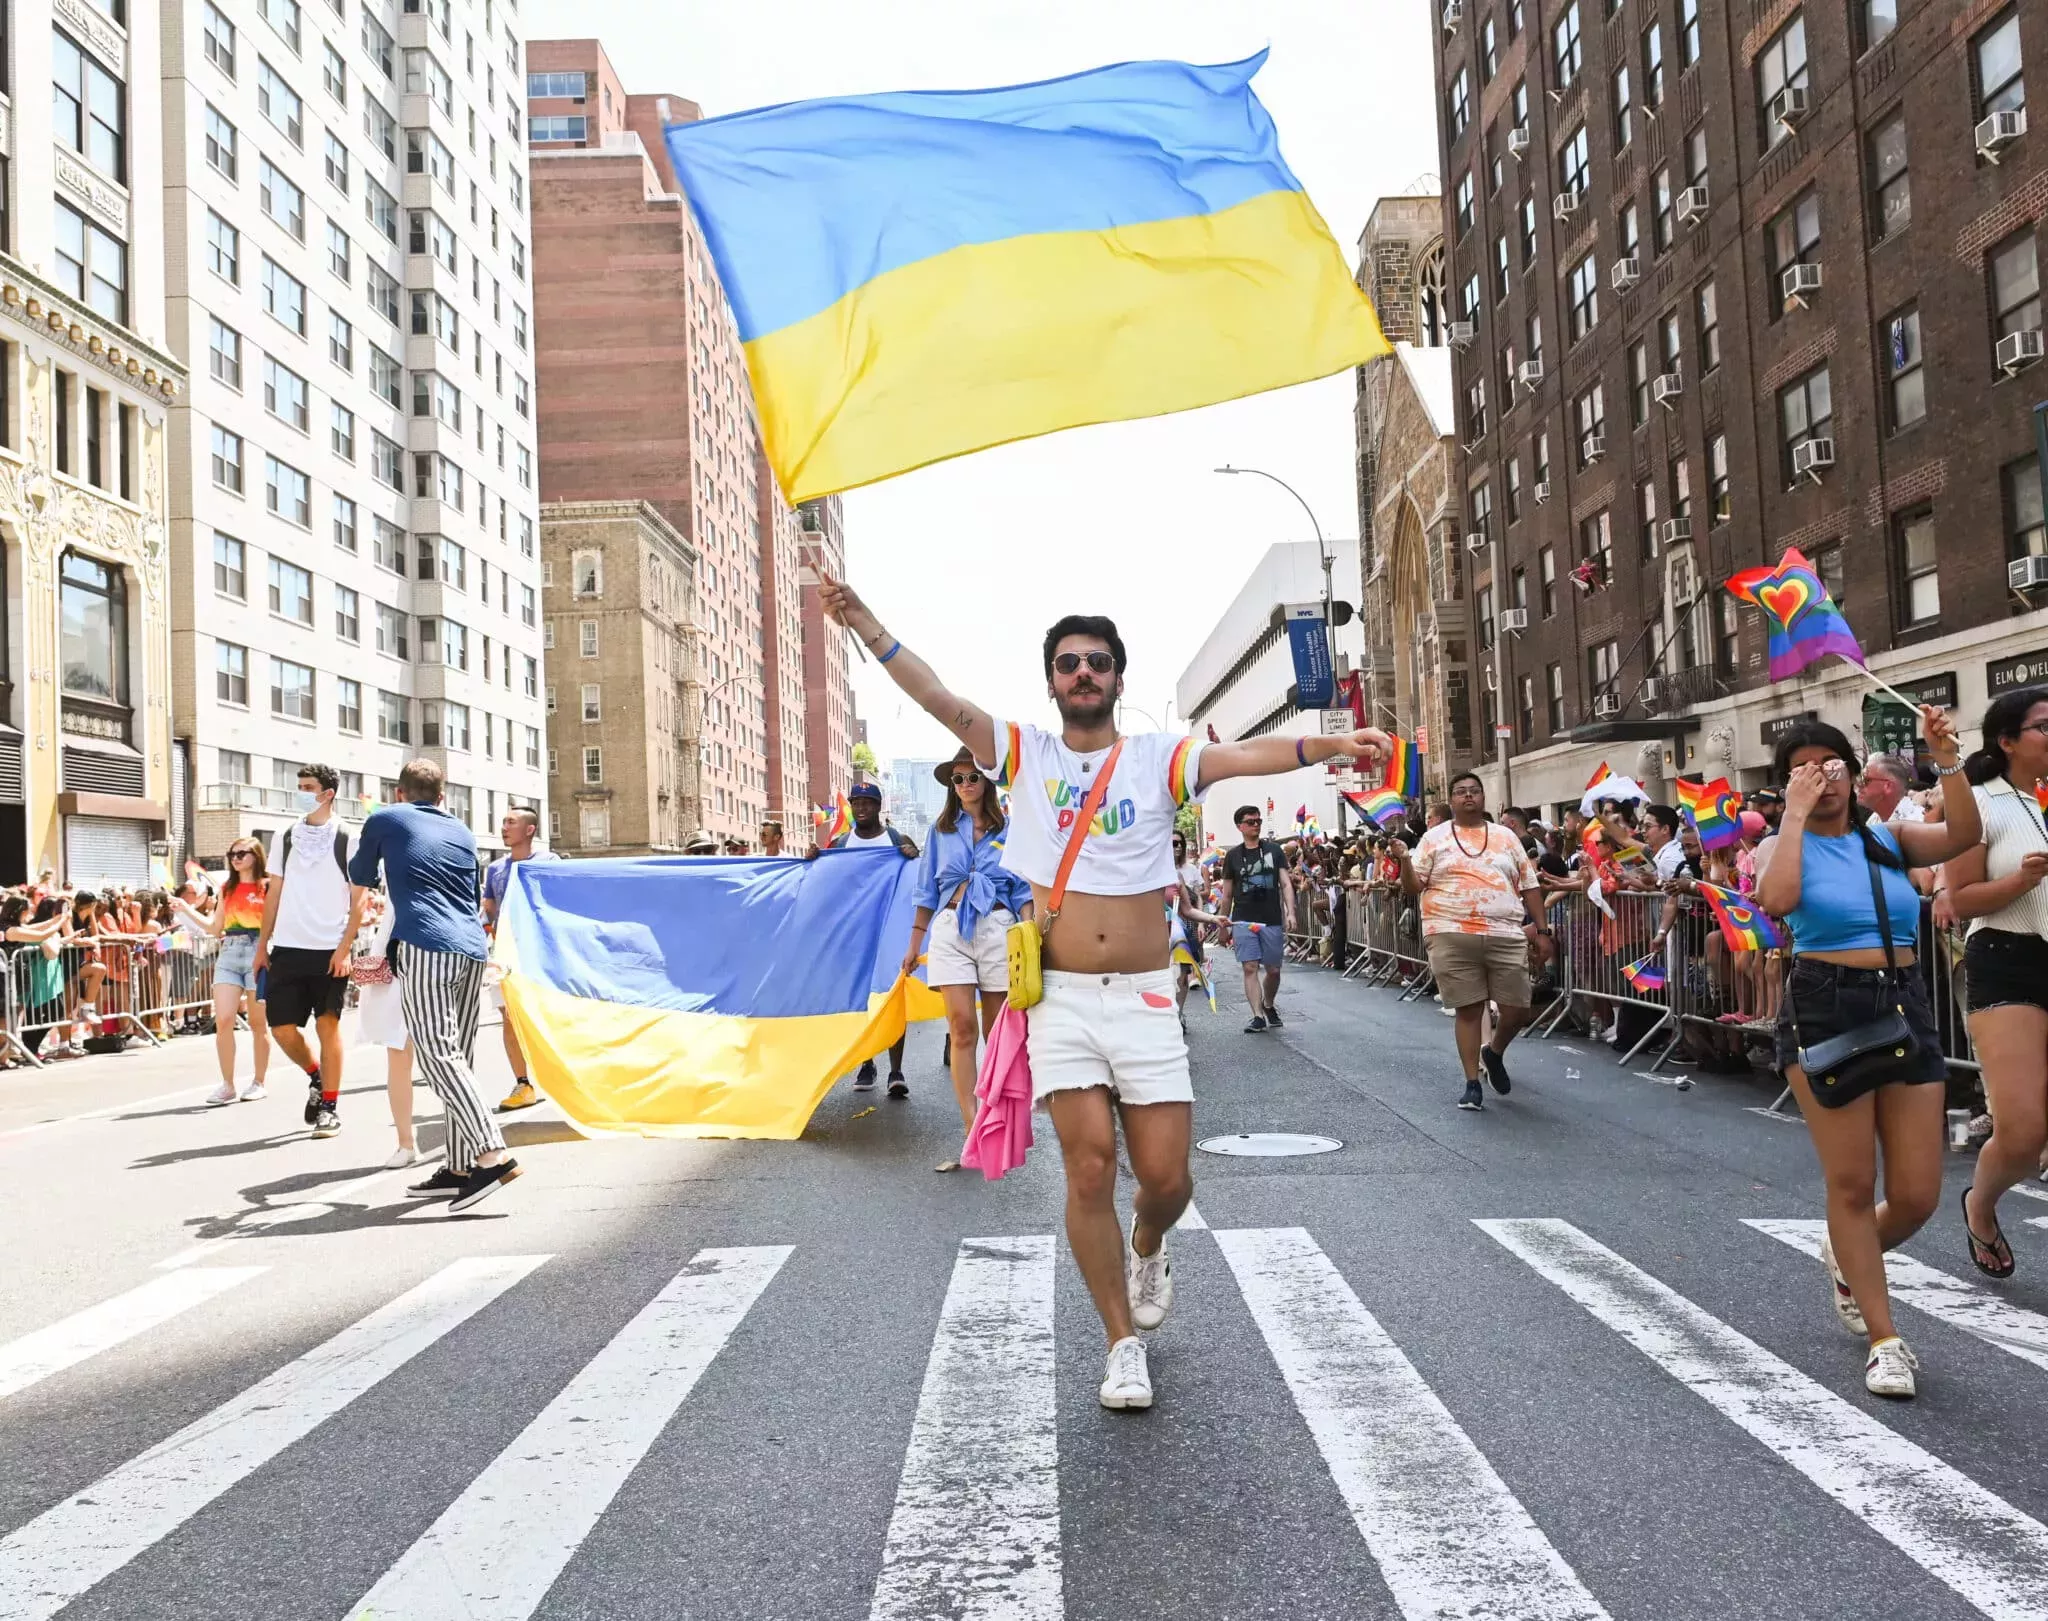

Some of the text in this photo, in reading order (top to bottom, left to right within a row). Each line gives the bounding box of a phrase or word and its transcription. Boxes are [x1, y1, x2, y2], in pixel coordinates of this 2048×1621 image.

[1306, 631, 1314, 655] Health
[1995, 669, 2014, 685] ELM
[1772, 719, 1794, 732] BIRCH
[1058, 798, 1135, 837] POUD
